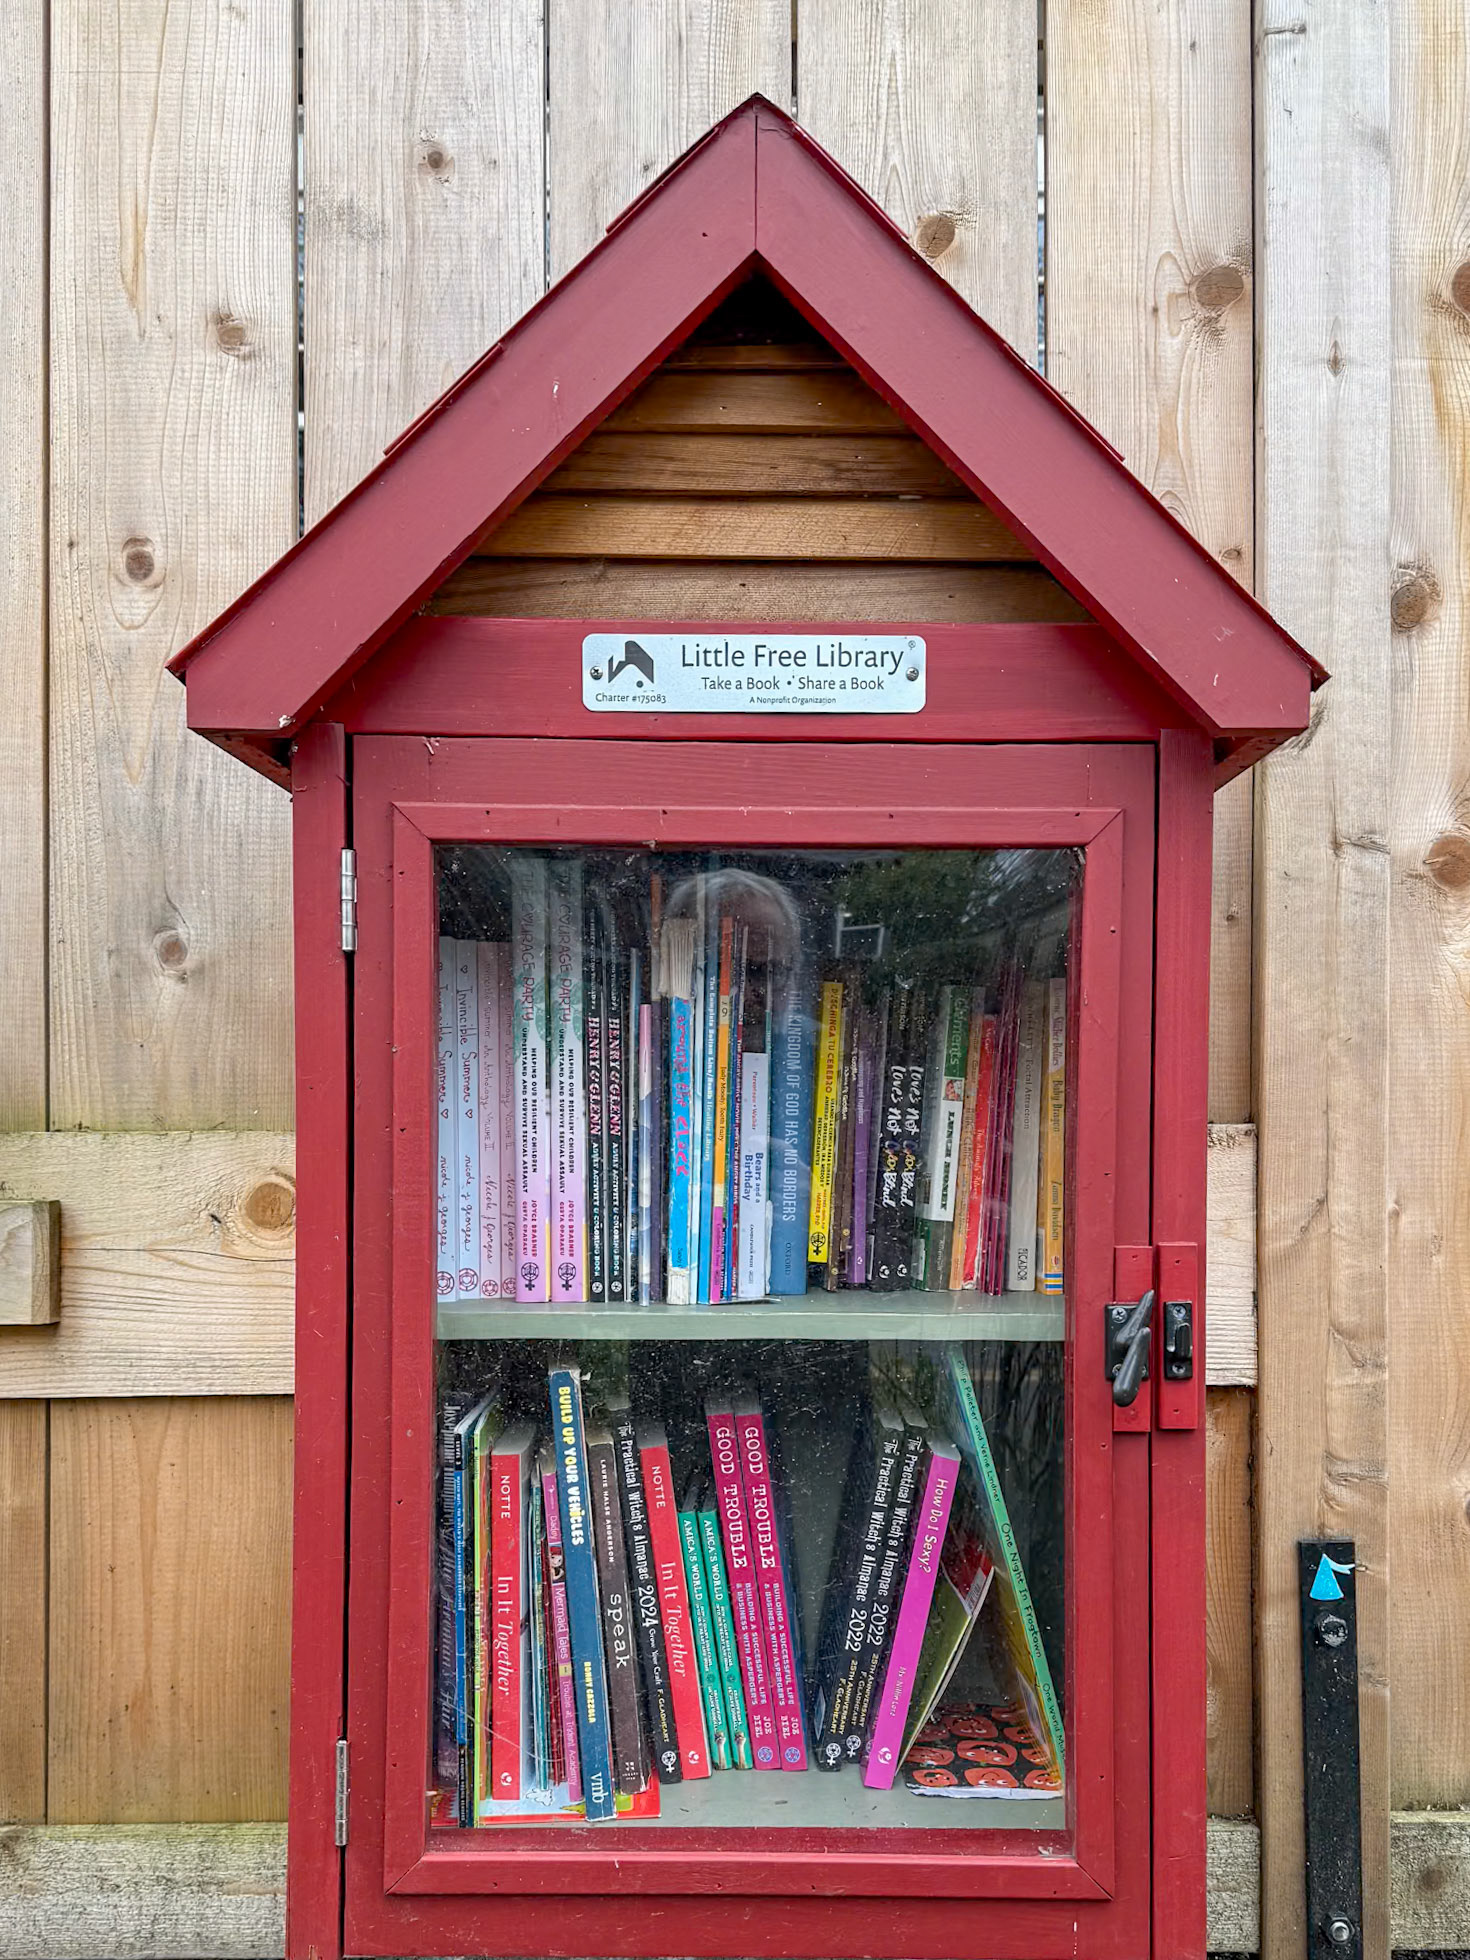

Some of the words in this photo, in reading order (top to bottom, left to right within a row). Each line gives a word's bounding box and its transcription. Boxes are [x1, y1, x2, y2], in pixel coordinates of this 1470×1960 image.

[682, 642, 745, 667] Little
[754, 644, 807, 667] Free
[816, 642, 904, 675] Library
[595, 692, 629, 702] Charter
[631, 694, 667, 703] #175083
[701, 675, 732, 690] Take
[735, 679, 743, 690] a
[746, 675, 780, 690] Book
[798, 676, 836, 690] Share
[839, 679, 847, 690] a
[850, 676, 885, 690] Book
[749, 696, 755, 704] A
[756, 696, 790, 705] Nonprofit
[791, 696, 836, 705] Organization
[521, 977, 535, 1021] PARTY
[558, 978, 571, 1023] PARTY
[708, 976, 716, 991] The
[788, 990, 801, 1011] THE
[456, 986, 477, 1045] Invincible
[708, 993, 716, 1027] Complete
[588, 1016, 600, 1066] HENRY
[608, 1018, 620, 1067] HENRY
[786, 1015, 801, 1070] KINGDOM
[828, 1040, 836, 1051] TU
[461, 1051, 478, 1103] Summer
[718, 1066, 727, 1081] Judy
[786, 1075, 800, 1088] OF
[825, 1052, 835, 1093] CEREBRO
[1051, 1080, 1063, 1101] Baby
[589, 1083, 601, 1135] GLENN
[609, 1084, 621, 1136] GLENN
[785, 1093, 800, 1116] GOD
[717, 1126, 725, 1142] Fairy
[784, 1121, 799, 1145] HAS
[945, 1111, 955, 1158] LUNCH
[755, 1152, 764, 1181] Bears
[784, 1149, 798, 1164] NO
[485, 1176, 497, 1210] Nicole
[592, 1169, 600, 1206] ACTIVITY
[612, 1169, 620, 1206] ACTIVITY
[741, 1154, 753, 1201] Birthday
[782, 1169, 797, 1221] BORDERS
[941, 1161, 950, 1210] MONEY
[463, 1205, 472, 1252] georges
[482, 1223, 497, 1264] Georges
[593, 1215, 601, 1254] COLORING
[612, 1215, 620, 1254] COLORING
[593, 1255, 601, 1277] BOOK
[612, 1255, 620, 1276] BOOK
[784, 1242, 792, 1275] OXFORD
[1017, 1248, 1028, 1281] PICADOR
[558, 1386, 573, 1424] BUILD
[562, 1427, 575, 1445] UP
[618, 1422, 634, 1437] The
[883, 1439, 900, 1454] The
[907, 1436, 924, 1451] The
[563, 1447, 580, 1483] YOUR
[621, 1440, 639, 1488] Practical
[716, 1427, 735, 1474] GOOD
[744, 1427, 763, 1474] GOOD
[600, 1459, 608, 1488] LAURIE
[652, 1466, 666, 1509] NOTTE
[873, 1457, 895, 1506] Practical
[896, 1454, 919, 1503] Practical
[980, 1444, 992, 1467] Verne
[986, 1470, 1001, 1503] Lindner
[500, 1475, 511, 1519] NOTTE
[602, 1491, 610, 1516] HALSE
[628, 1491, 645, 1531] Witch's
[933, 1478, 949, 1507] How
[549, 1515, 559, 1540] Dadey
[723, 1484, 748, 1569] TROUBLE
[751, 1484, 776, 1569] TROUBLE
[864, 1511, 885, 1551] Witch's
[886, 1507, 908, 1546] Witch's
[930, 1508, 943, 1523] Do
[604, 1519, 615, 1562] ANDERSON
[683, 1519, 698, 1562] AMICA'S
[703, 1519, 718, 1562] AMICA'S
[1001, 1523, 1015, 1548] One
[634, 1535, 650, 1580] Almanac
[661, 1562, 677, 1581] In
[877, 1550, 898, 1596] Almanac
[918, 1535, 938, 1574] Sexy?
[1009, 1552, 1025, 1585] Night
[497, 1576, 513, 1593] In
[664, 1586, 679, 1599] It
[690, 1563, 702, 1600] WORLD
[710, 1563, 723, 1600] WORLD
[855, 1555, 876, 1602] Almanac
[1018, 1589, 1030, 1601] In
[497, 1600, 513, 1614] It
[554, 1587, 567, 1633] Mermaid
[638, 1585, 659, 1627] 2024
[765, 1591, 776, 1631] BUSINESS
[866, 1602, 889, 1646] 2022
[558, 1636, 570, 1659] Tales
[607, 1593, 631, 1668] speak
[648, 1629, 657, 1648] Grow
[663, 1605, 688, 1677] Together
[770, 1633, 779, 1654] WITH
[773, 1583, 784, 1622] BUILDING
[779, 1632, 793, 1685] SUCCESSFUL
[787, 1687, 795, 1705] LIFE
[844, 1608, 866, 1652] 2022
[1022, 1605, 1043, 1658] Frogtown
[493, 1621, 515, 1696] Together
[651, 1650, 660, 1665] Your
[653, 1666, 662, 1685] Craft
[562, 1681, 573, 1709] Trouble
[772, 1656, 785, 1706] ASPERGER'S
[1042, 1683, 1053, 1703] One
[754, 1715, 763, 1738] BIEL
[763, 1716, 772, 1735] JOE
[780, 1715, 790, 1738] BIEL
[791, 1717, 799, 1735] JOE
[830, 1688, 846, 1734] GLADHEART
[838, 1682, 854, 1735] ANNIVERSARY
[1047, 1705, 1062, 1733] World
[566, 1722, 576, 1747] Trident
[567, 1750, 578, 1786] Academy
[590, 1772, 609, 1803] vmb
